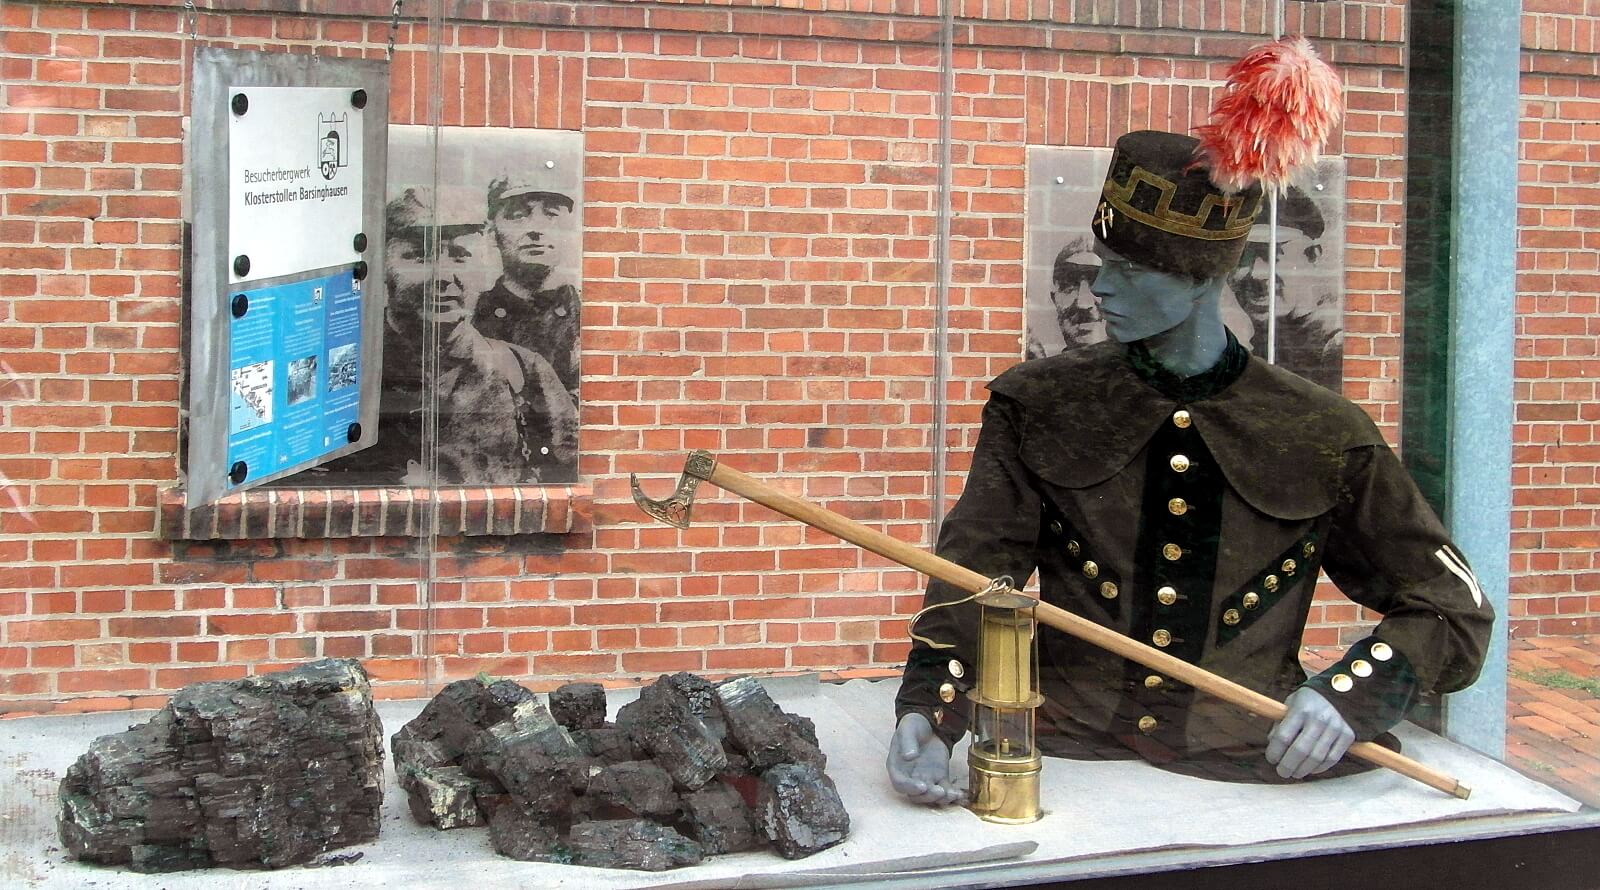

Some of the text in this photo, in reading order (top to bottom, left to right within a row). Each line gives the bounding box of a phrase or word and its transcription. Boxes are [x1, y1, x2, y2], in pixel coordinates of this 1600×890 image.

[244, 165, 311, 183] Besucherbergwerk
[244, 185, 348, 206] Klosterstollen Barsinghausen
